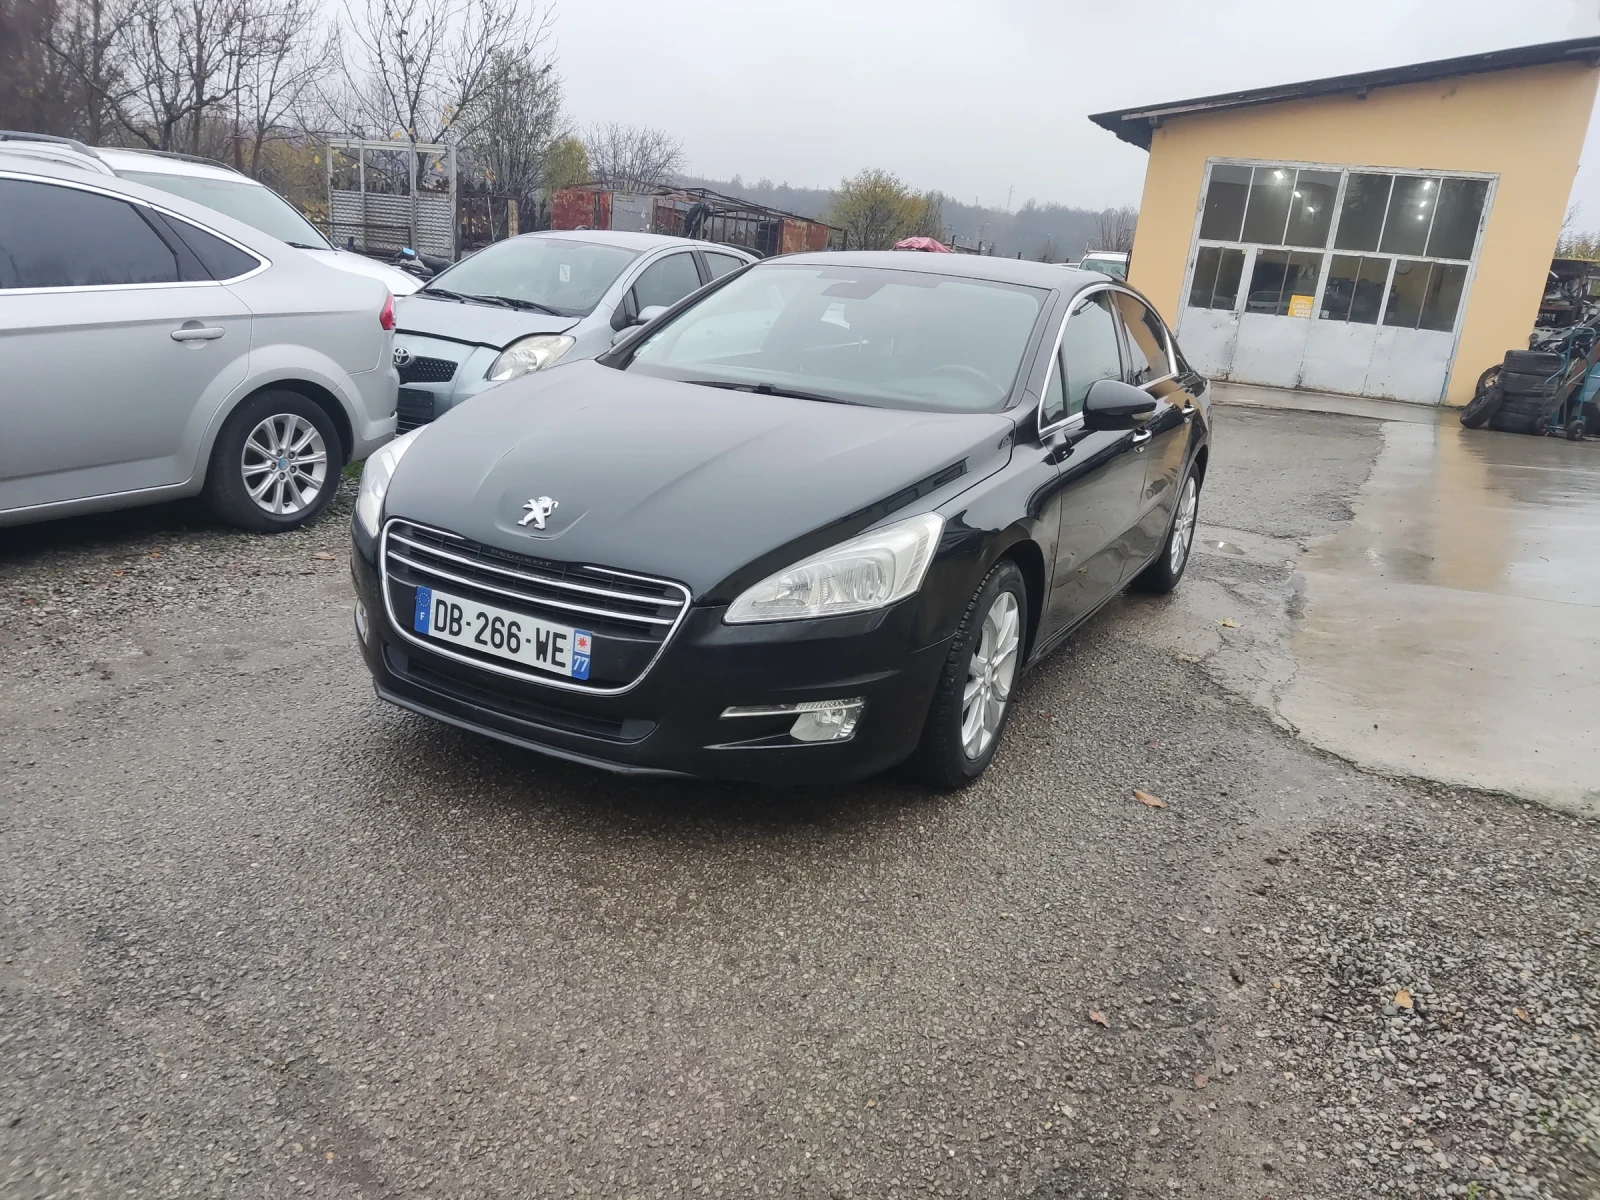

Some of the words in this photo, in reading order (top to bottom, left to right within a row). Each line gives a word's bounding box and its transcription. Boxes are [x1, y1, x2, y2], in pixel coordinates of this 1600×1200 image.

[491, 549, 552, 567] PEUGEOT
[419, 611, 425, 621] F
[434, 599, 567, 668] DB-266-WE
[573, 655, 589, 673] 77
